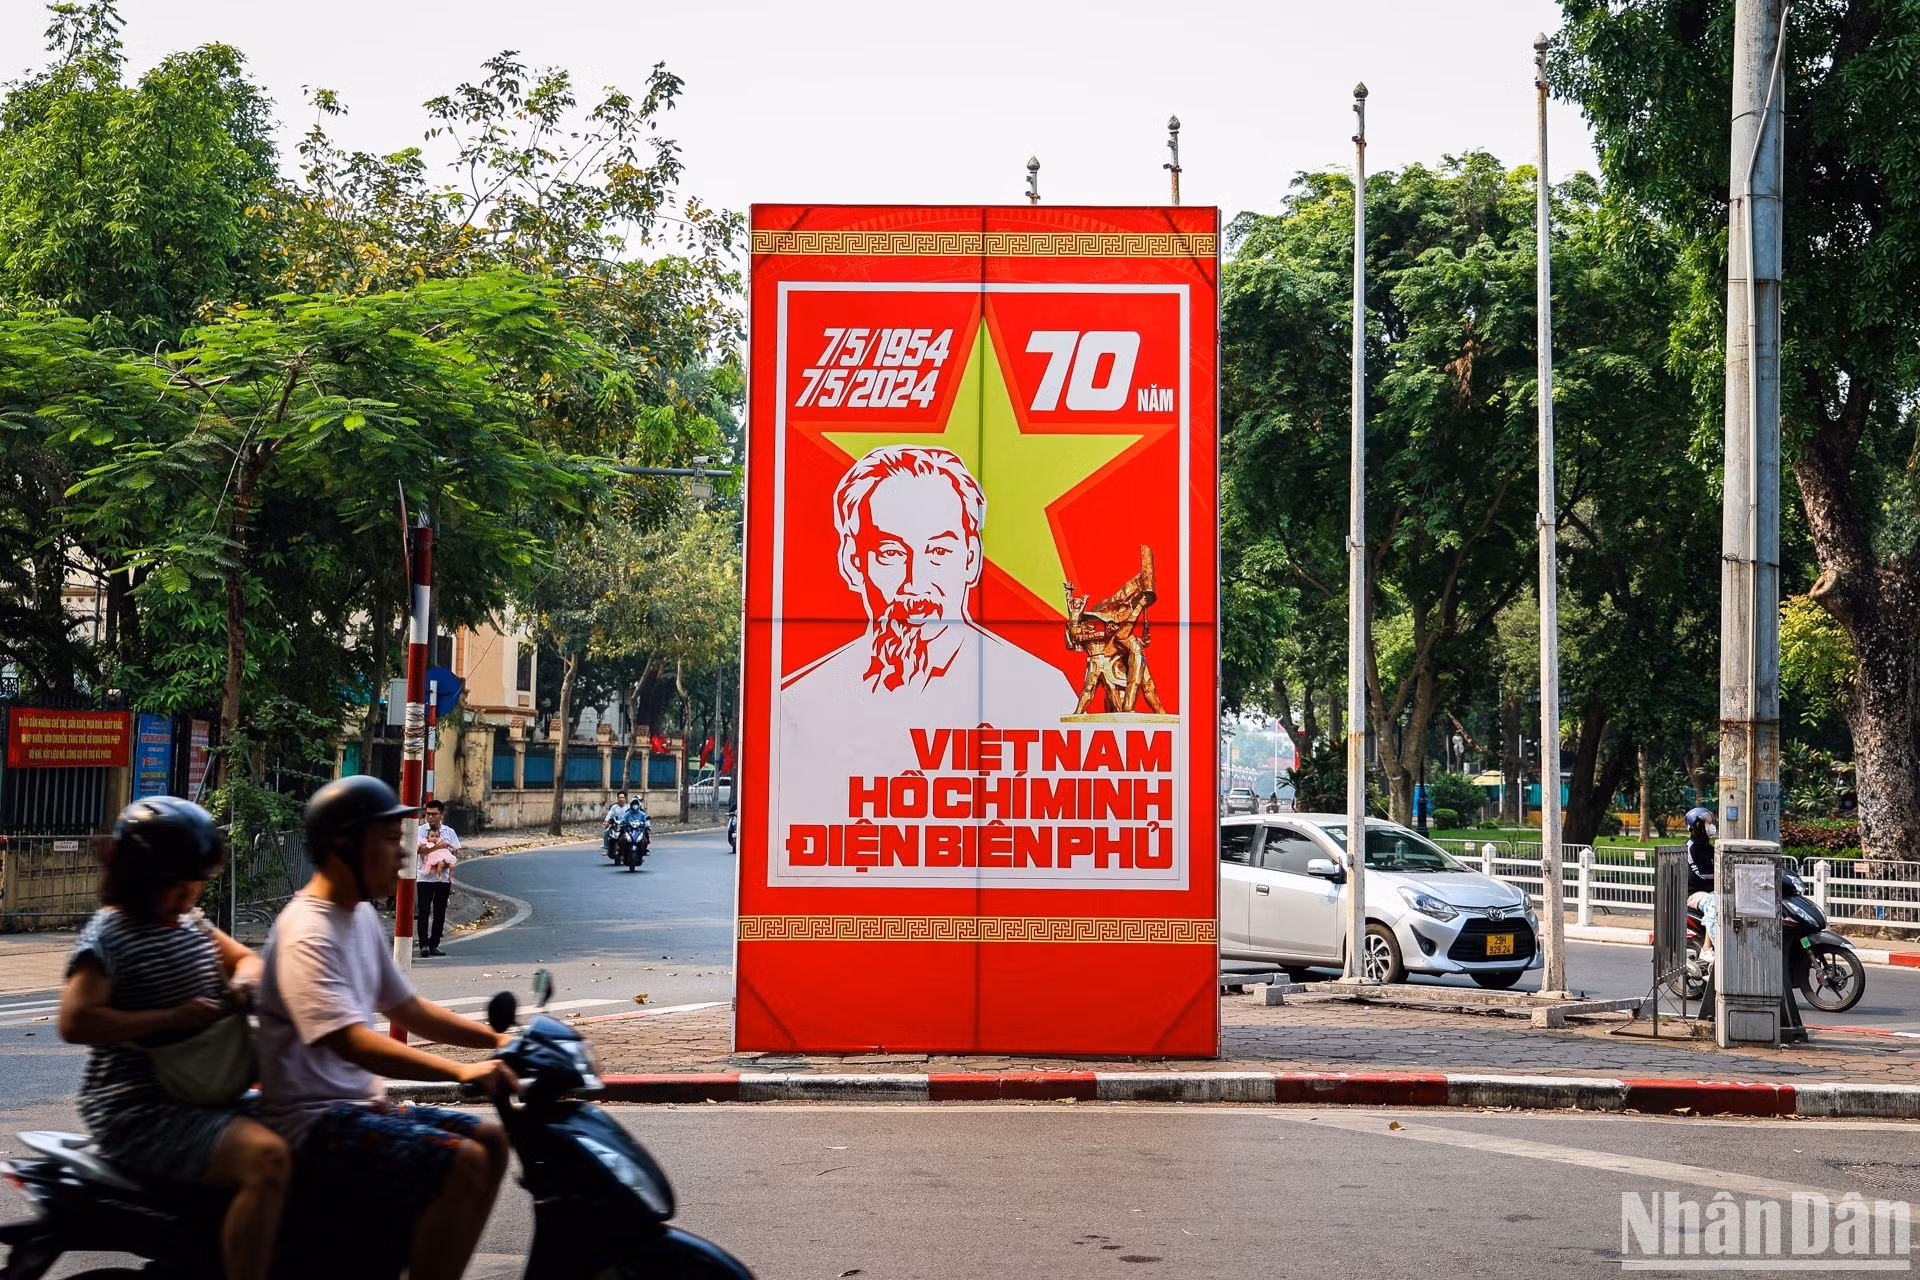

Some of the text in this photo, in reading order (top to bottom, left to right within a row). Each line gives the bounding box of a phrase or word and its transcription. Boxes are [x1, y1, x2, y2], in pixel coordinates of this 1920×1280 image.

[815, 328, 954, 368] 7/5/1954
[1024, 330, 1174, 412] 70 NĂM
[794, 369, 940, 408] 7/5/2024
[909, 722, 1173, 777] VIỆT NAM
[848, 768, 1173, 821] HỒ CHÍ MINH
[785, 819, 1173, 873] ĐIỆN BIÊN PHỦ
